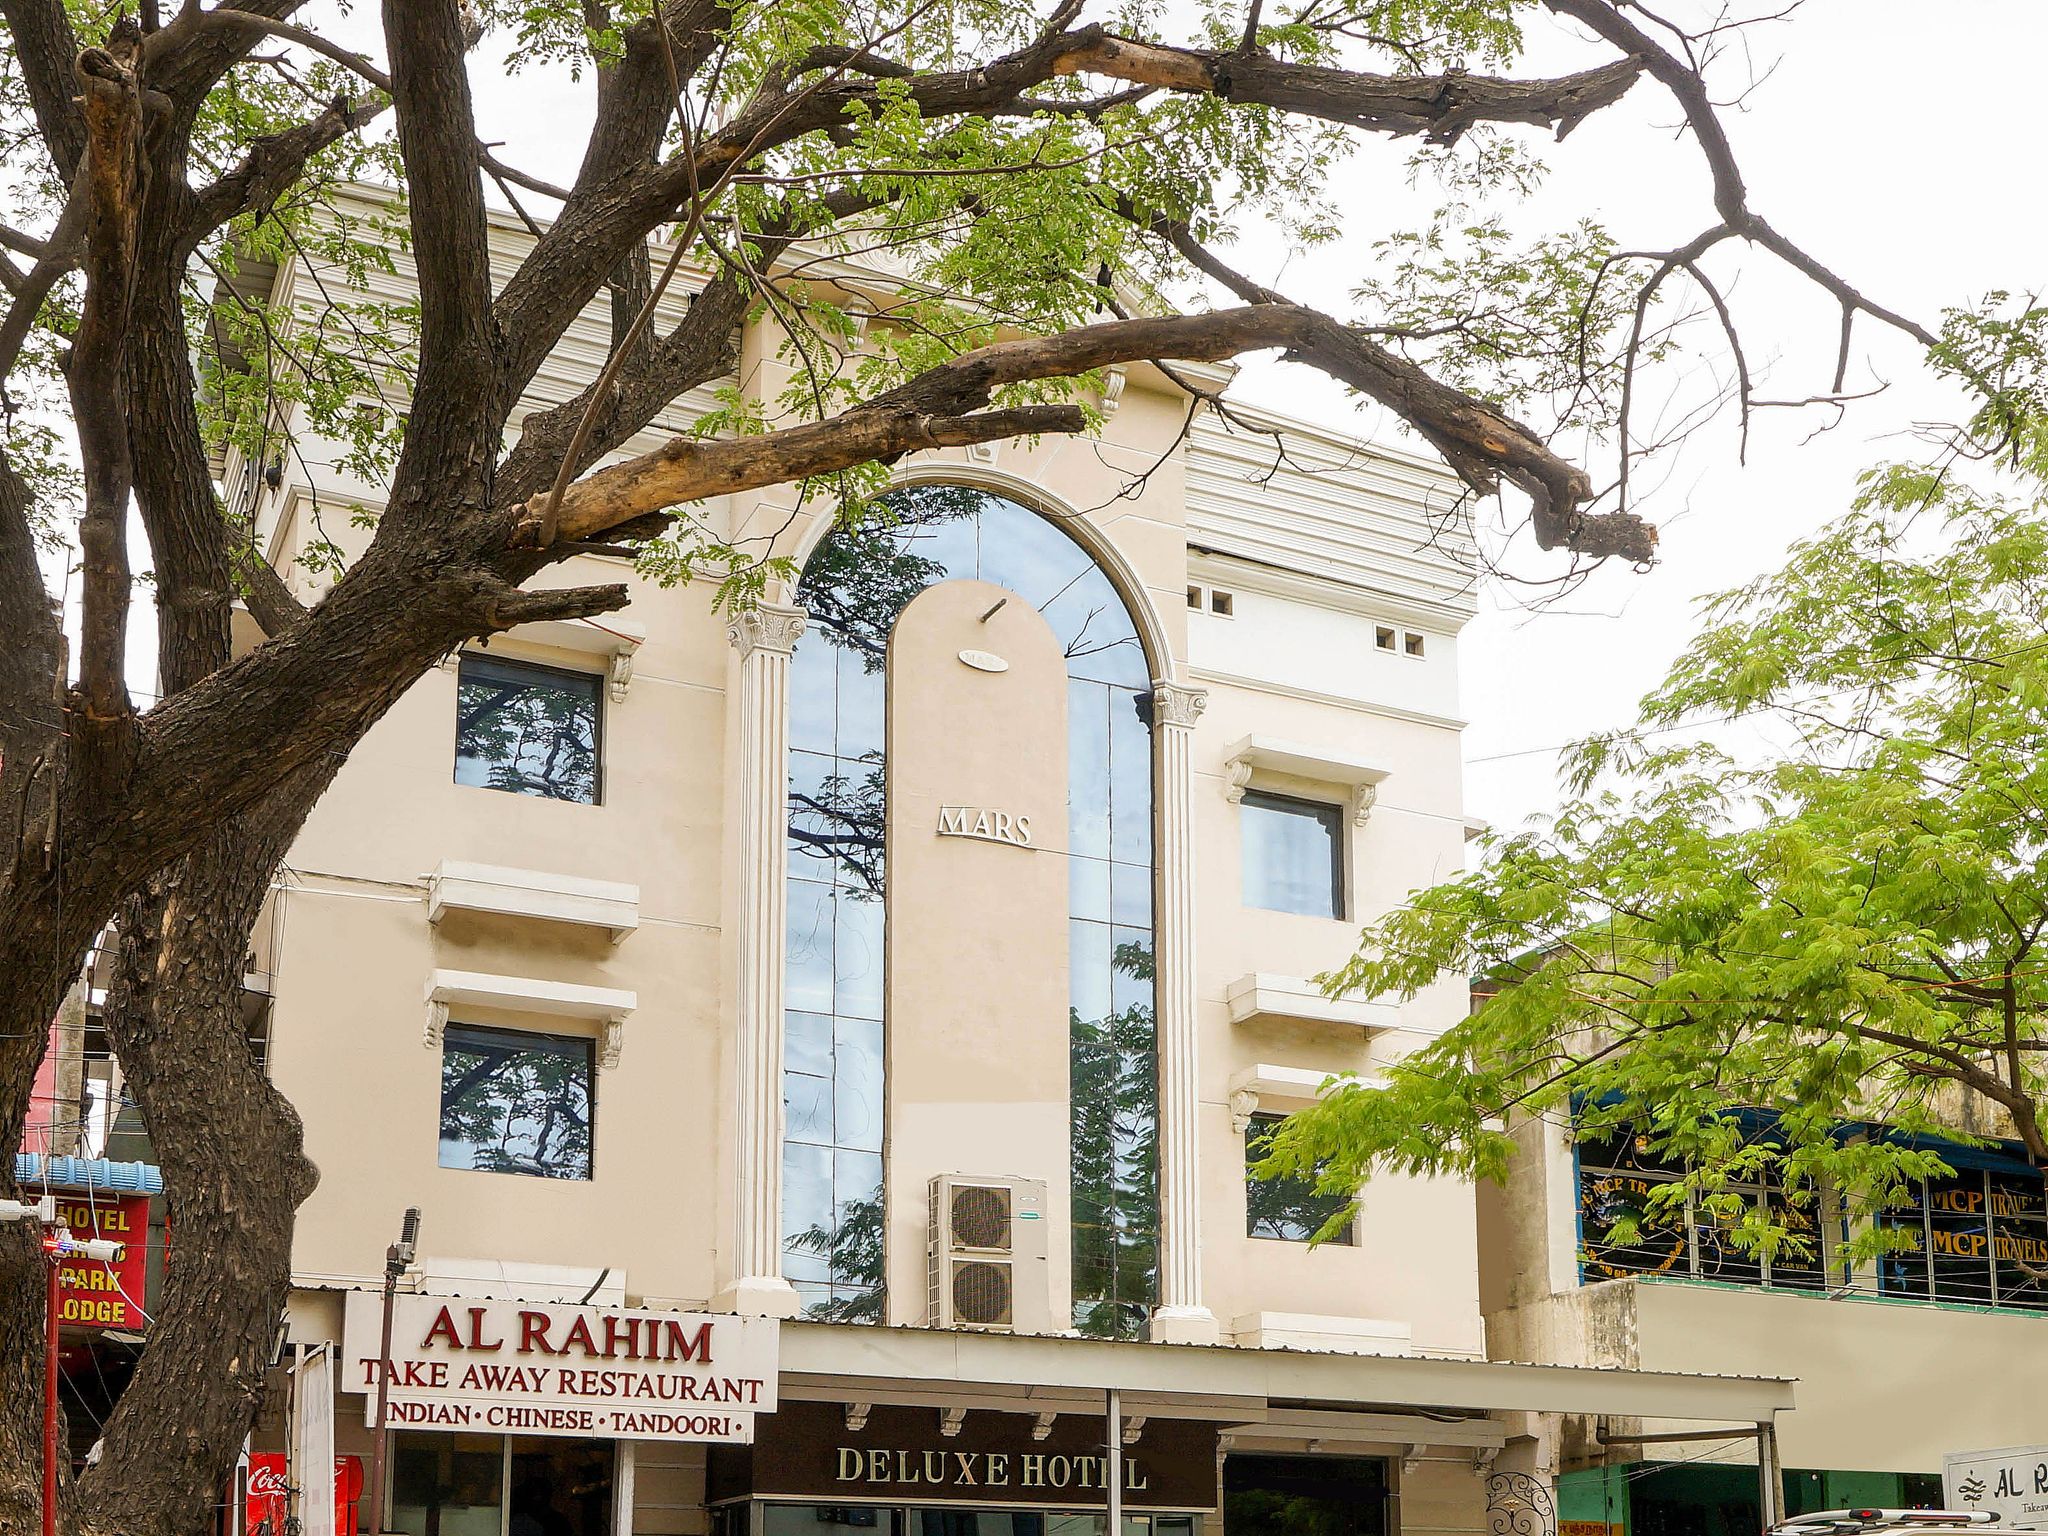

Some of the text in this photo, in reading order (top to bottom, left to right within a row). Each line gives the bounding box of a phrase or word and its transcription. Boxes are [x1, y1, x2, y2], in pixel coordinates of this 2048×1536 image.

[936, 804, 1031, 845] MARS
[1930, 1190, 1983, 1213] MCP
[57, 1206, 130, 1231] HOTEL
[1932, 1230, 2048, 1262] MCP TRAVELS
[60, 1267, 121, 1292] PARK
[57, 1298, 126, 1323] ODGE
[420, 1305, 715, 1363] AL RAHIM
[359, 1358, 764, 1404] TAKE AWAY RESTAURANT
[386, 1402, 730, 1436] NDIAN CHINESE TANDOORI
[836, 1447, 1009, 1486] DELUXE
[1994, 1467, 2024, 1498] AL
[2021, 1502, 2048, 1513] Takeaw
